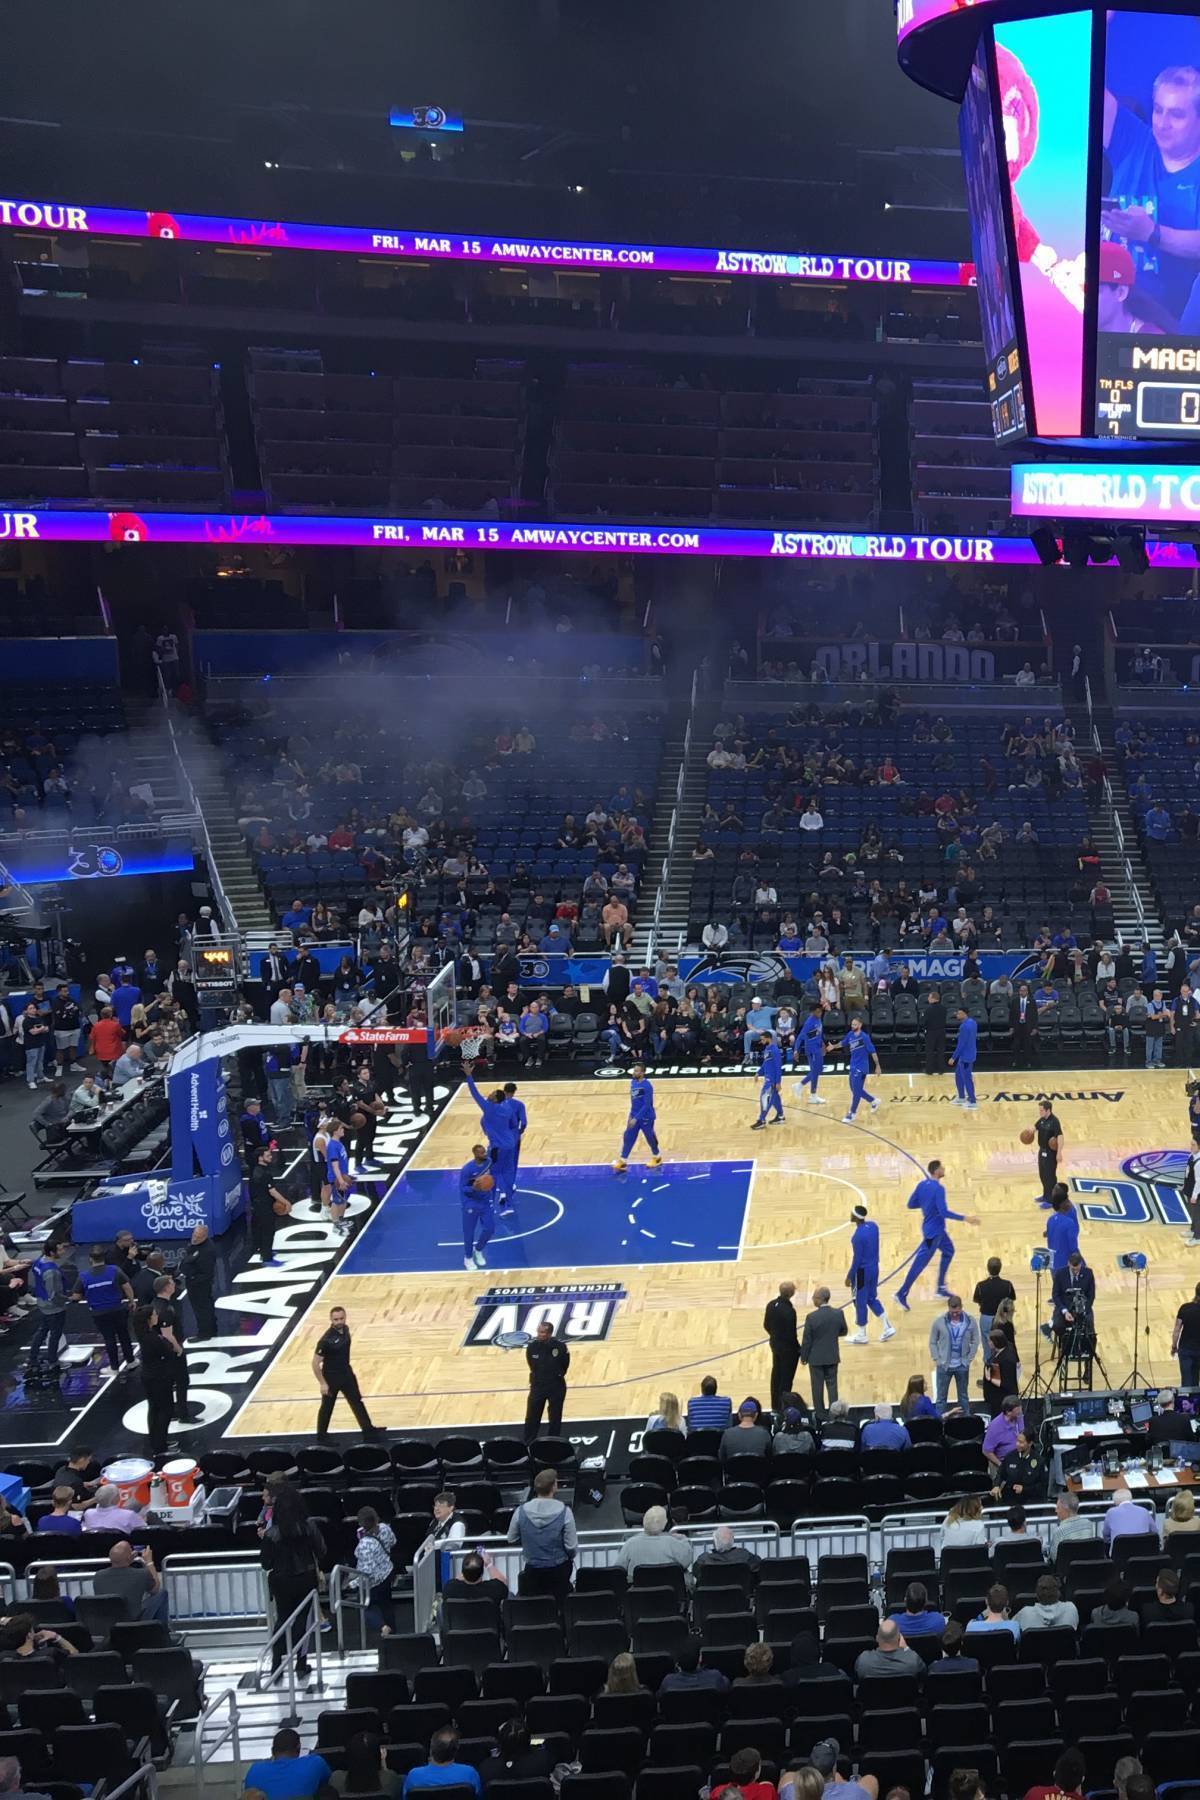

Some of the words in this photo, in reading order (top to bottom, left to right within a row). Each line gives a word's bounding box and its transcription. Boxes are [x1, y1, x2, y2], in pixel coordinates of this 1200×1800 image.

[0, 201, 88, 230] TOUR
[372, 235, 404, 251] FRI,
[415, 238, 451, 252] MAR
[462, 241, 481, 254] 15
[491, 243, 655, 264] AMWAYCENTER.COM
[838, 259, 911, 281] TOUR
[1099, 379, 1112, 389] TM
[1115, 380, 1134, 390] FLS
[1110, 389, 1120, 403] 0
[1181, 392, 1200, 423] 0
[373, 525, 410, 542] FRI,
[422, 526, 465, 541] MAR
[477, 528, 499, 542] 15
[510, 527, 700, 548] AMWAYCENTER.COM
[911, 537, 993, 561] TOUR
[816, 642, 995, 682] ORLANDO
[520, 959, 550, 979] 30
[909, 960, 982, 977] MAGI
[190, 1072, 200, 1132] AdventHealth
[889, 1094, 991, 1104] CNTER
[993, 1091, 1125, 1102] Amway
[141, 1202, 184, 1217] Olive
[147, 1216, 205, 1234] Garden
[494, 1287, 536, 1295] DEVOS
[560, 1284, 617, 1293] RICHARD
[473, 1300, 610, 1341] RDV
[172, 1481, 183, 1492] G
